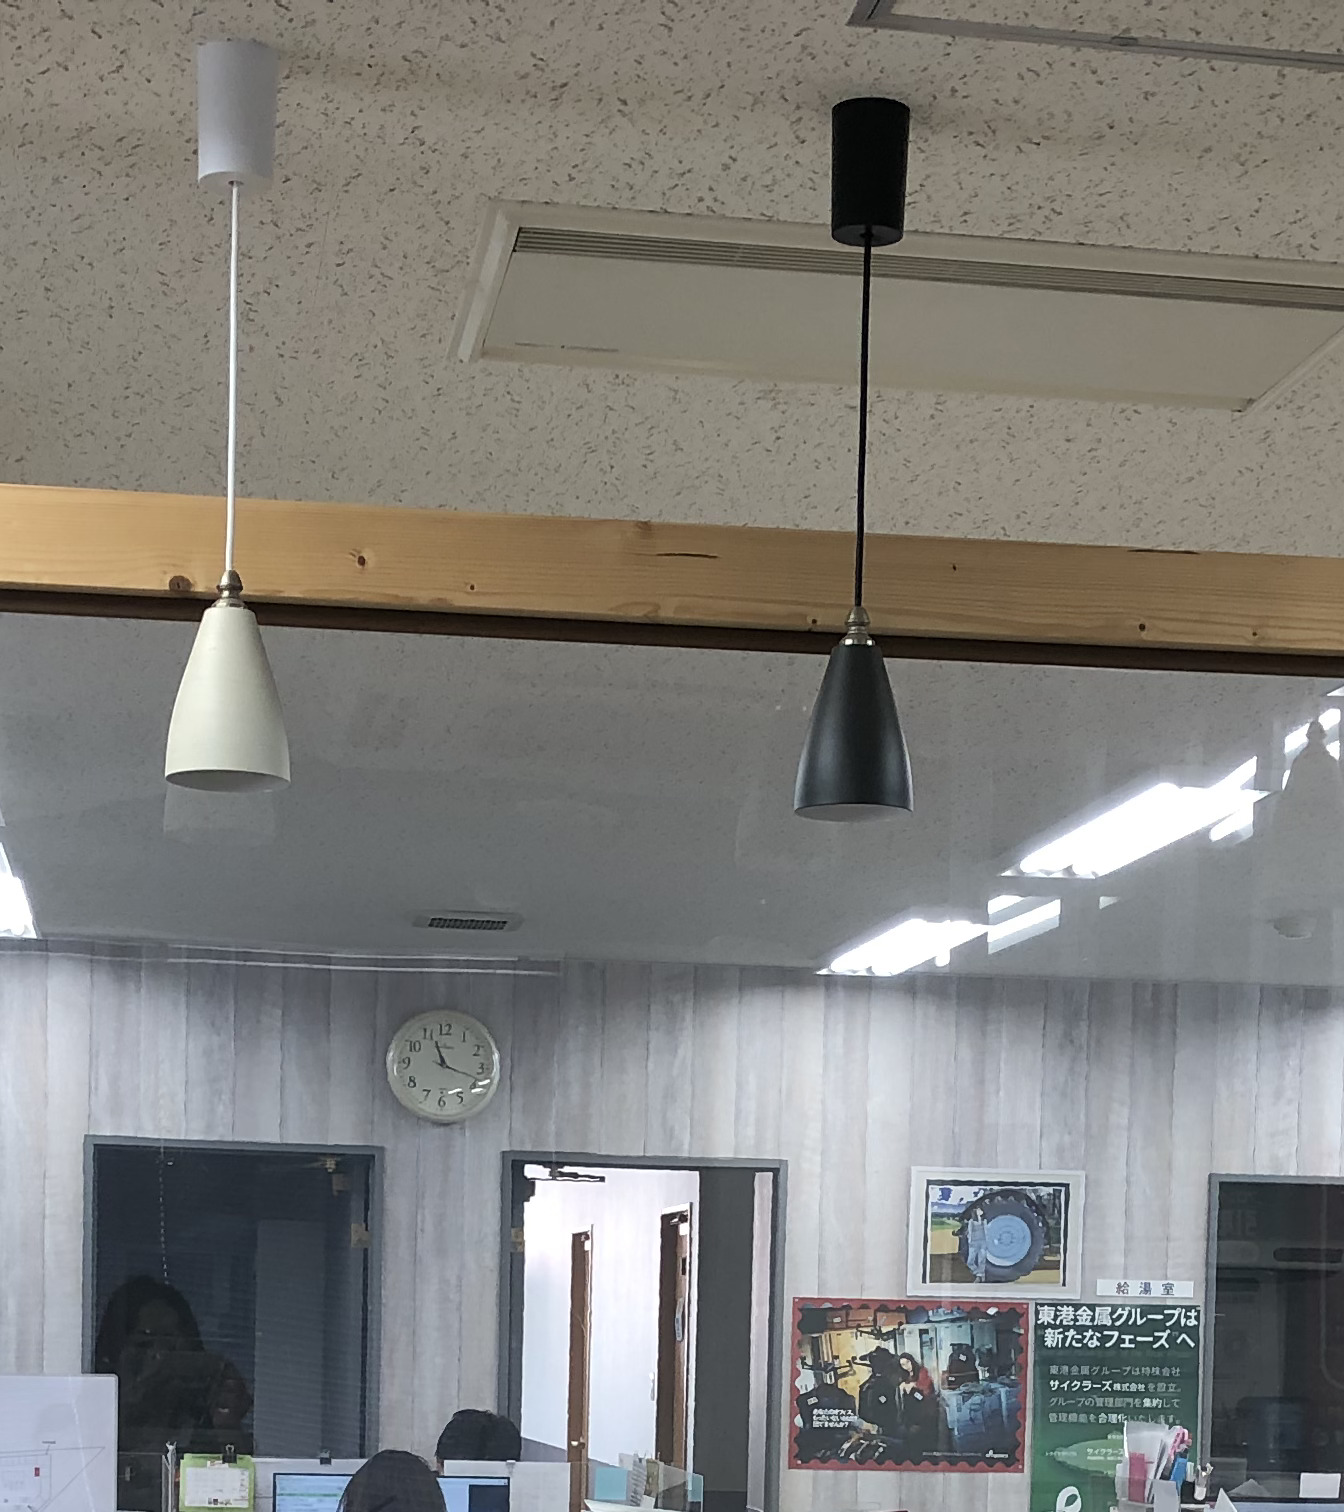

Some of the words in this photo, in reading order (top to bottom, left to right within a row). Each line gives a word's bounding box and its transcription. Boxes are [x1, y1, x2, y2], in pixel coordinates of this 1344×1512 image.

[438, 1023, 453, 1036] 12
[461, 1031, 466, 1042] 1
[408, 1040, 422, 1052] 10
[473, 1044, 482, 1057] 2
[402, 1057, 411, 1070] 9
[476, 1063, 485, 1075] 3
[407, 1076, 417, 1088] 8
[422, 1089, 432, 1101] 7
[437, 1095, 446, 1108] 6
[456, 1091, 464, 1105] 5
[1037, 1305, 1198, 1327] 東港金属グループは
[1044, 1328, 1196, 1349] 新たなフェーズへ
